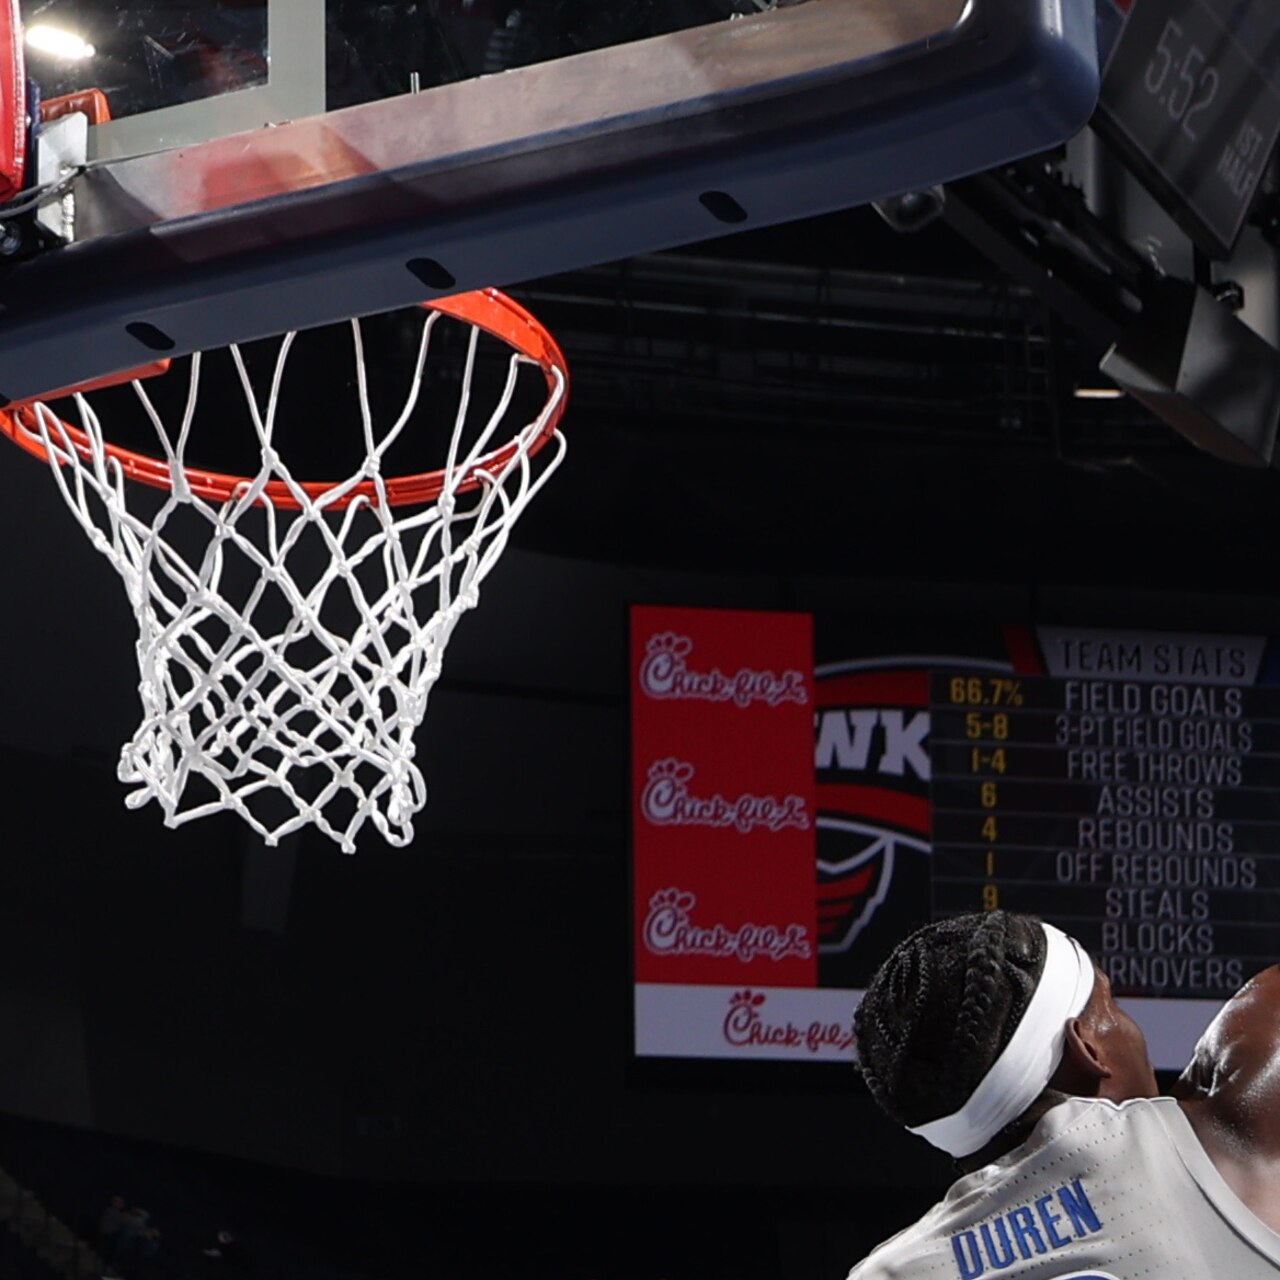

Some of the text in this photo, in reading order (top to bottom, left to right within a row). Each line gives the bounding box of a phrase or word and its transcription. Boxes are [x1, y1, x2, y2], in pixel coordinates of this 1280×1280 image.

[1144, 18, 1220, 142] 5:52
[1061, 640, 1245, 677] TEAM STATS
[949, 676, 1024, 706] 66.7%
[1064, 680, 1142, 714] FIELD
[1149, 684, 1243, 718] GOALS
[965, 713, 1009, 741] 5-8
[1055, 713, 1107, 747] 3-PT
[1112, 717, 1173, 749] FIELD
[1179, 719, 1253, 753] GOALS
[970, 747, 1007, 775] 1-4
[1066, 750, 1129, 783] FREE
[1137, 752, 1243, 786] THROWS
[980, 781, 998, 809] 6
[1096, 784, 1214, 820] ASSISTS
[981, 816, 999, 842] 4
[1077, 818, 1234, 853] REBOUNDS
[1055, 851, 1104, 883] OFF
[1111, 853, 1257, 890] REBOUNDS
[982, 884, 1210, 922] 9 STEALS
[1101, 922, 1214, 955] BLOCKS
[1101, 953, 1243, 990] RNOVERS
